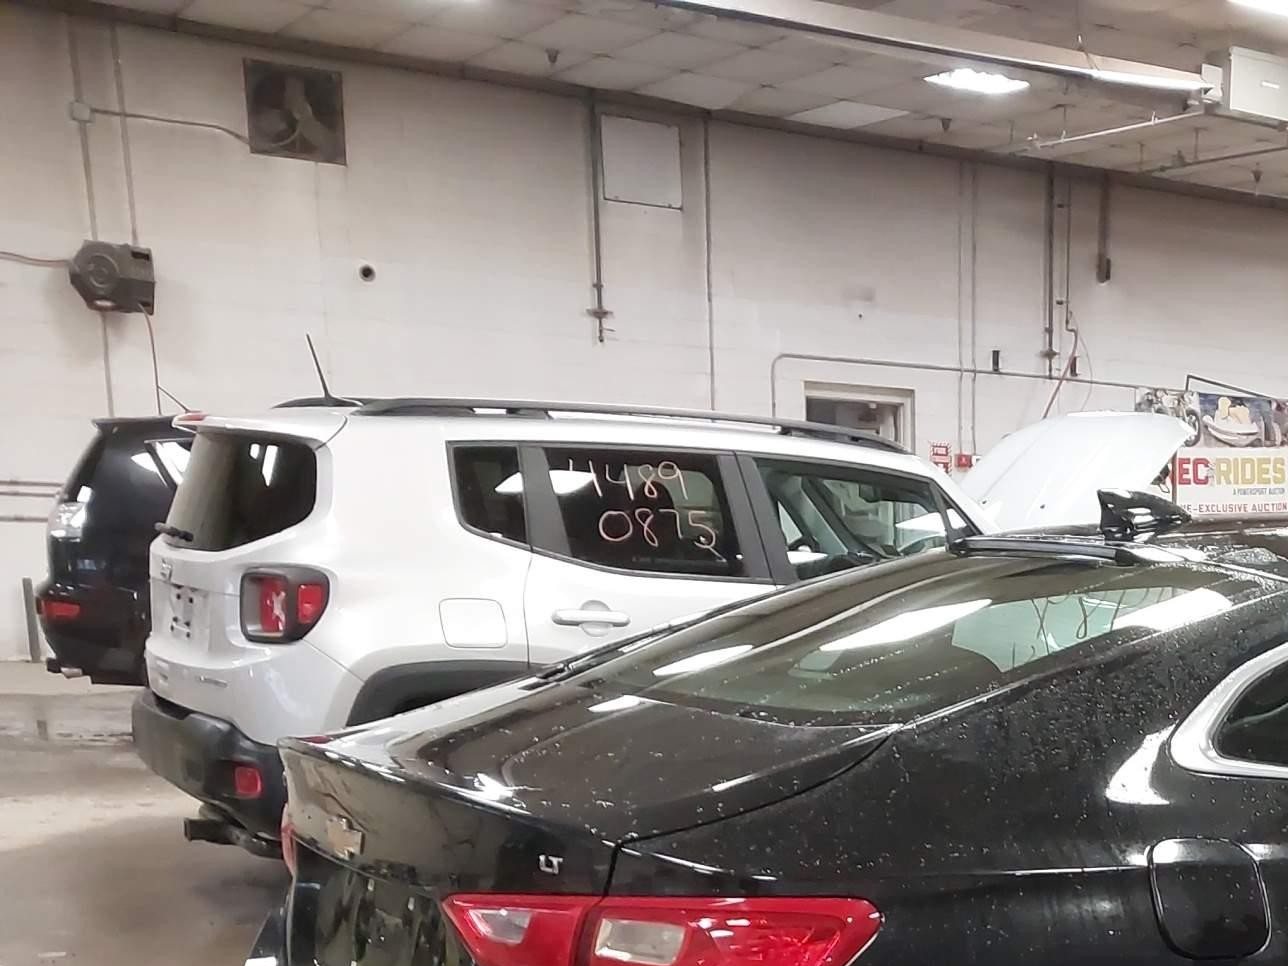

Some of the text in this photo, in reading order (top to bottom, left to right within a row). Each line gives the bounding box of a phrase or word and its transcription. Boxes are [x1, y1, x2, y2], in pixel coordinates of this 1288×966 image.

[1176, 456, 1286, 485] EC RIDES
[1251, 502, 1288, 513] AUCTION
[598, 508, 723, 556] 0875
[538, 853, 564, 875] LT
